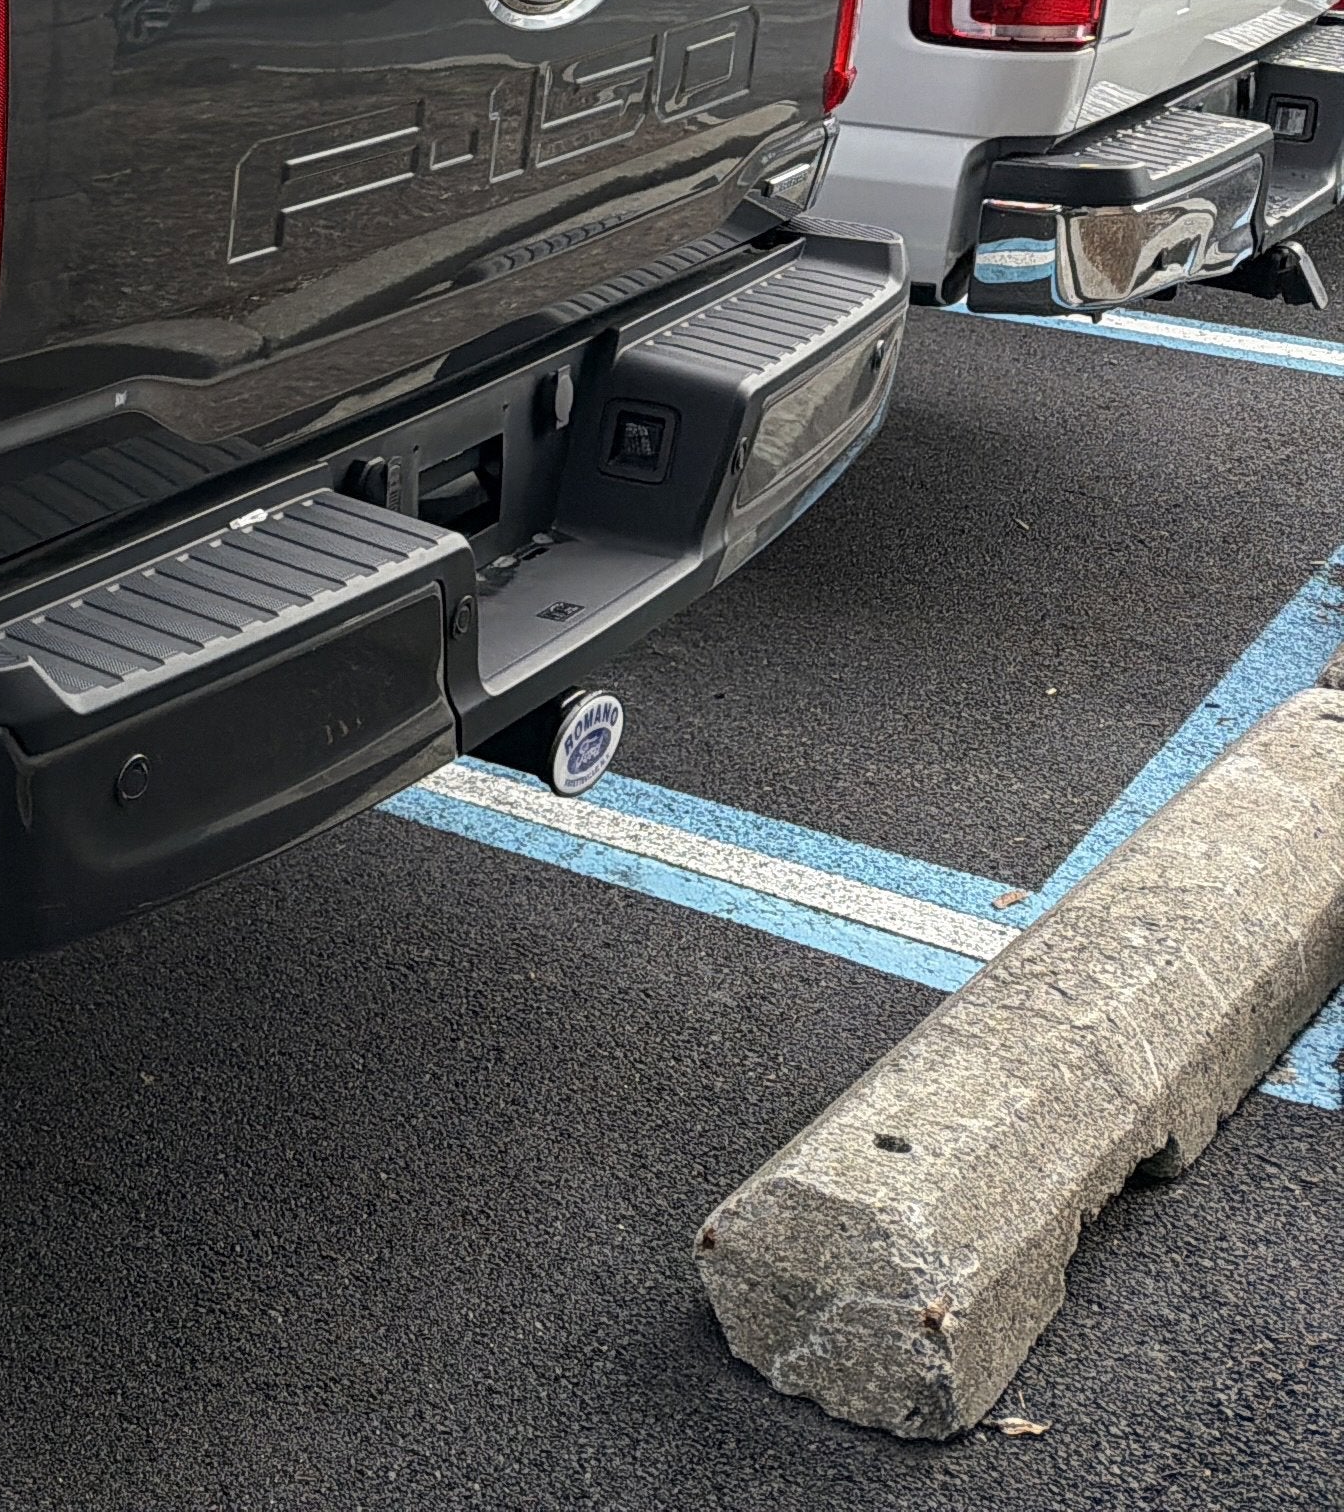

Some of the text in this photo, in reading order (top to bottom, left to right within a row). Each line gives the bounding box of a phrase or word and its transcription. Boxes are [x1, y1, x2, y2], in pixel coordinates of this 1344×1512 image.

[228, 5, 759, 264] F-150
[564, 703, 618, 755] ROMANO
[576, 735, 604, 768] Ford
